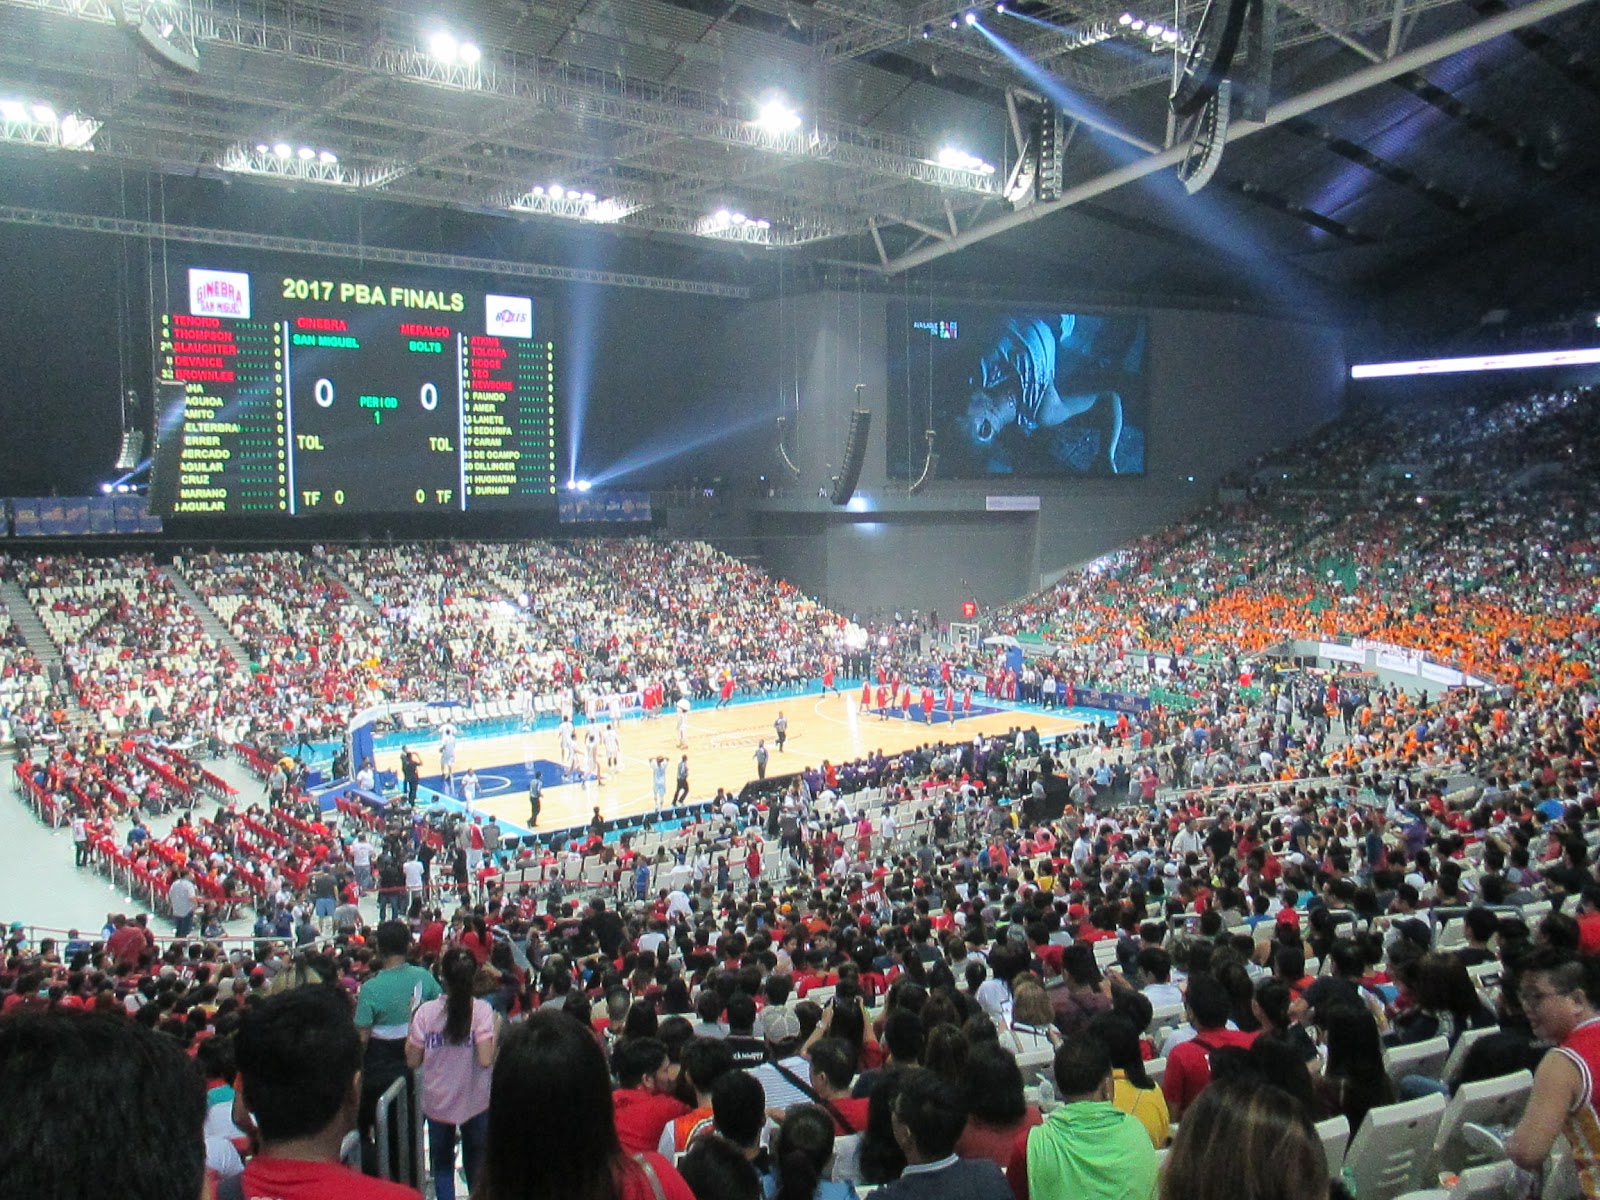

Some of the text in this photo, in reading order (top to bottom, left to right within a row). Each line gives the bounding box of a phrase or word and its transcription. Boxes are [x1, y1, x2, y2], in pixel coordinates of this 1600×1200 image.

[197, 281, 242, 305] GINEBRA
[283, 278, 464, 312] 2017 PBA FINALS
[172, 315, 221, 328] TENORIO
[296, 317, 347, 331] GINEBRA
[173, 328, 234, 342] THOMPSON
[400, 324, 450, 337] MERALCO
[173, 342, 239, 355] SLAUGHTER
[292, 334, 360, 349] SAN MIGUEL
[409, 341, 441, 353] BOLTS
[314, 378, 334, 408] 0
[420, 382, 437, 411] 0
[185, 396, 224, 407] AGUIOA
[373, 410, 381, 425] 1
[184, 435, 221, 447] ERRER
[297, 435, 325, 450] TOL
[429, 437, 454, 452] TOL
[181, 474, 210, 485] CRUZ
[302, 491, 321, 506] TF
[334, 490, 345, 505] 0
[415, 489, 426, 504] 0
[436, 490, 452, 504] TF
